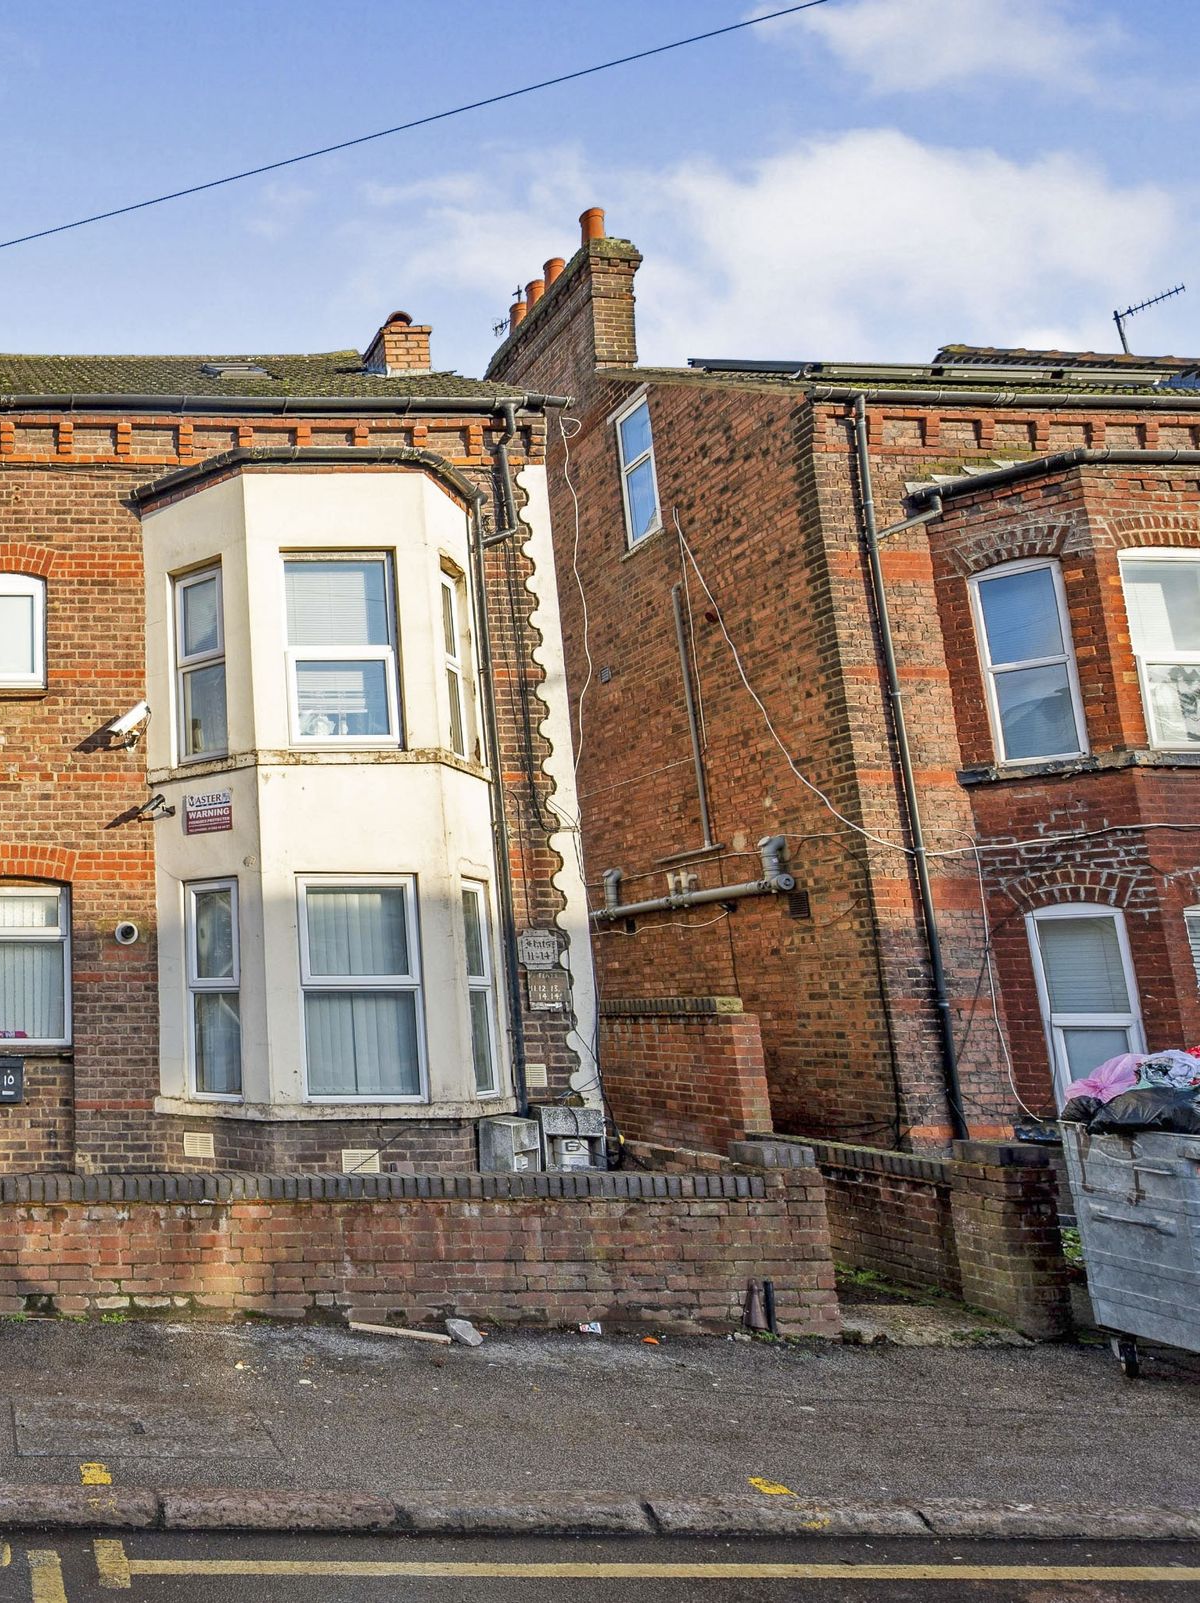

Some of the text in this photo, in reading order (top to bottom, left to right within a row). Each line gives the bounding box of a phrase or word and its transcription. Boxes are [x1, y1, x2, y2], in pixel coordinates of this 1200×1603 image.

[187, 793, 221, 807] MASTER
[188, 807, 230, 819] WARNING
[3, 1075, 15, 1086] 10
